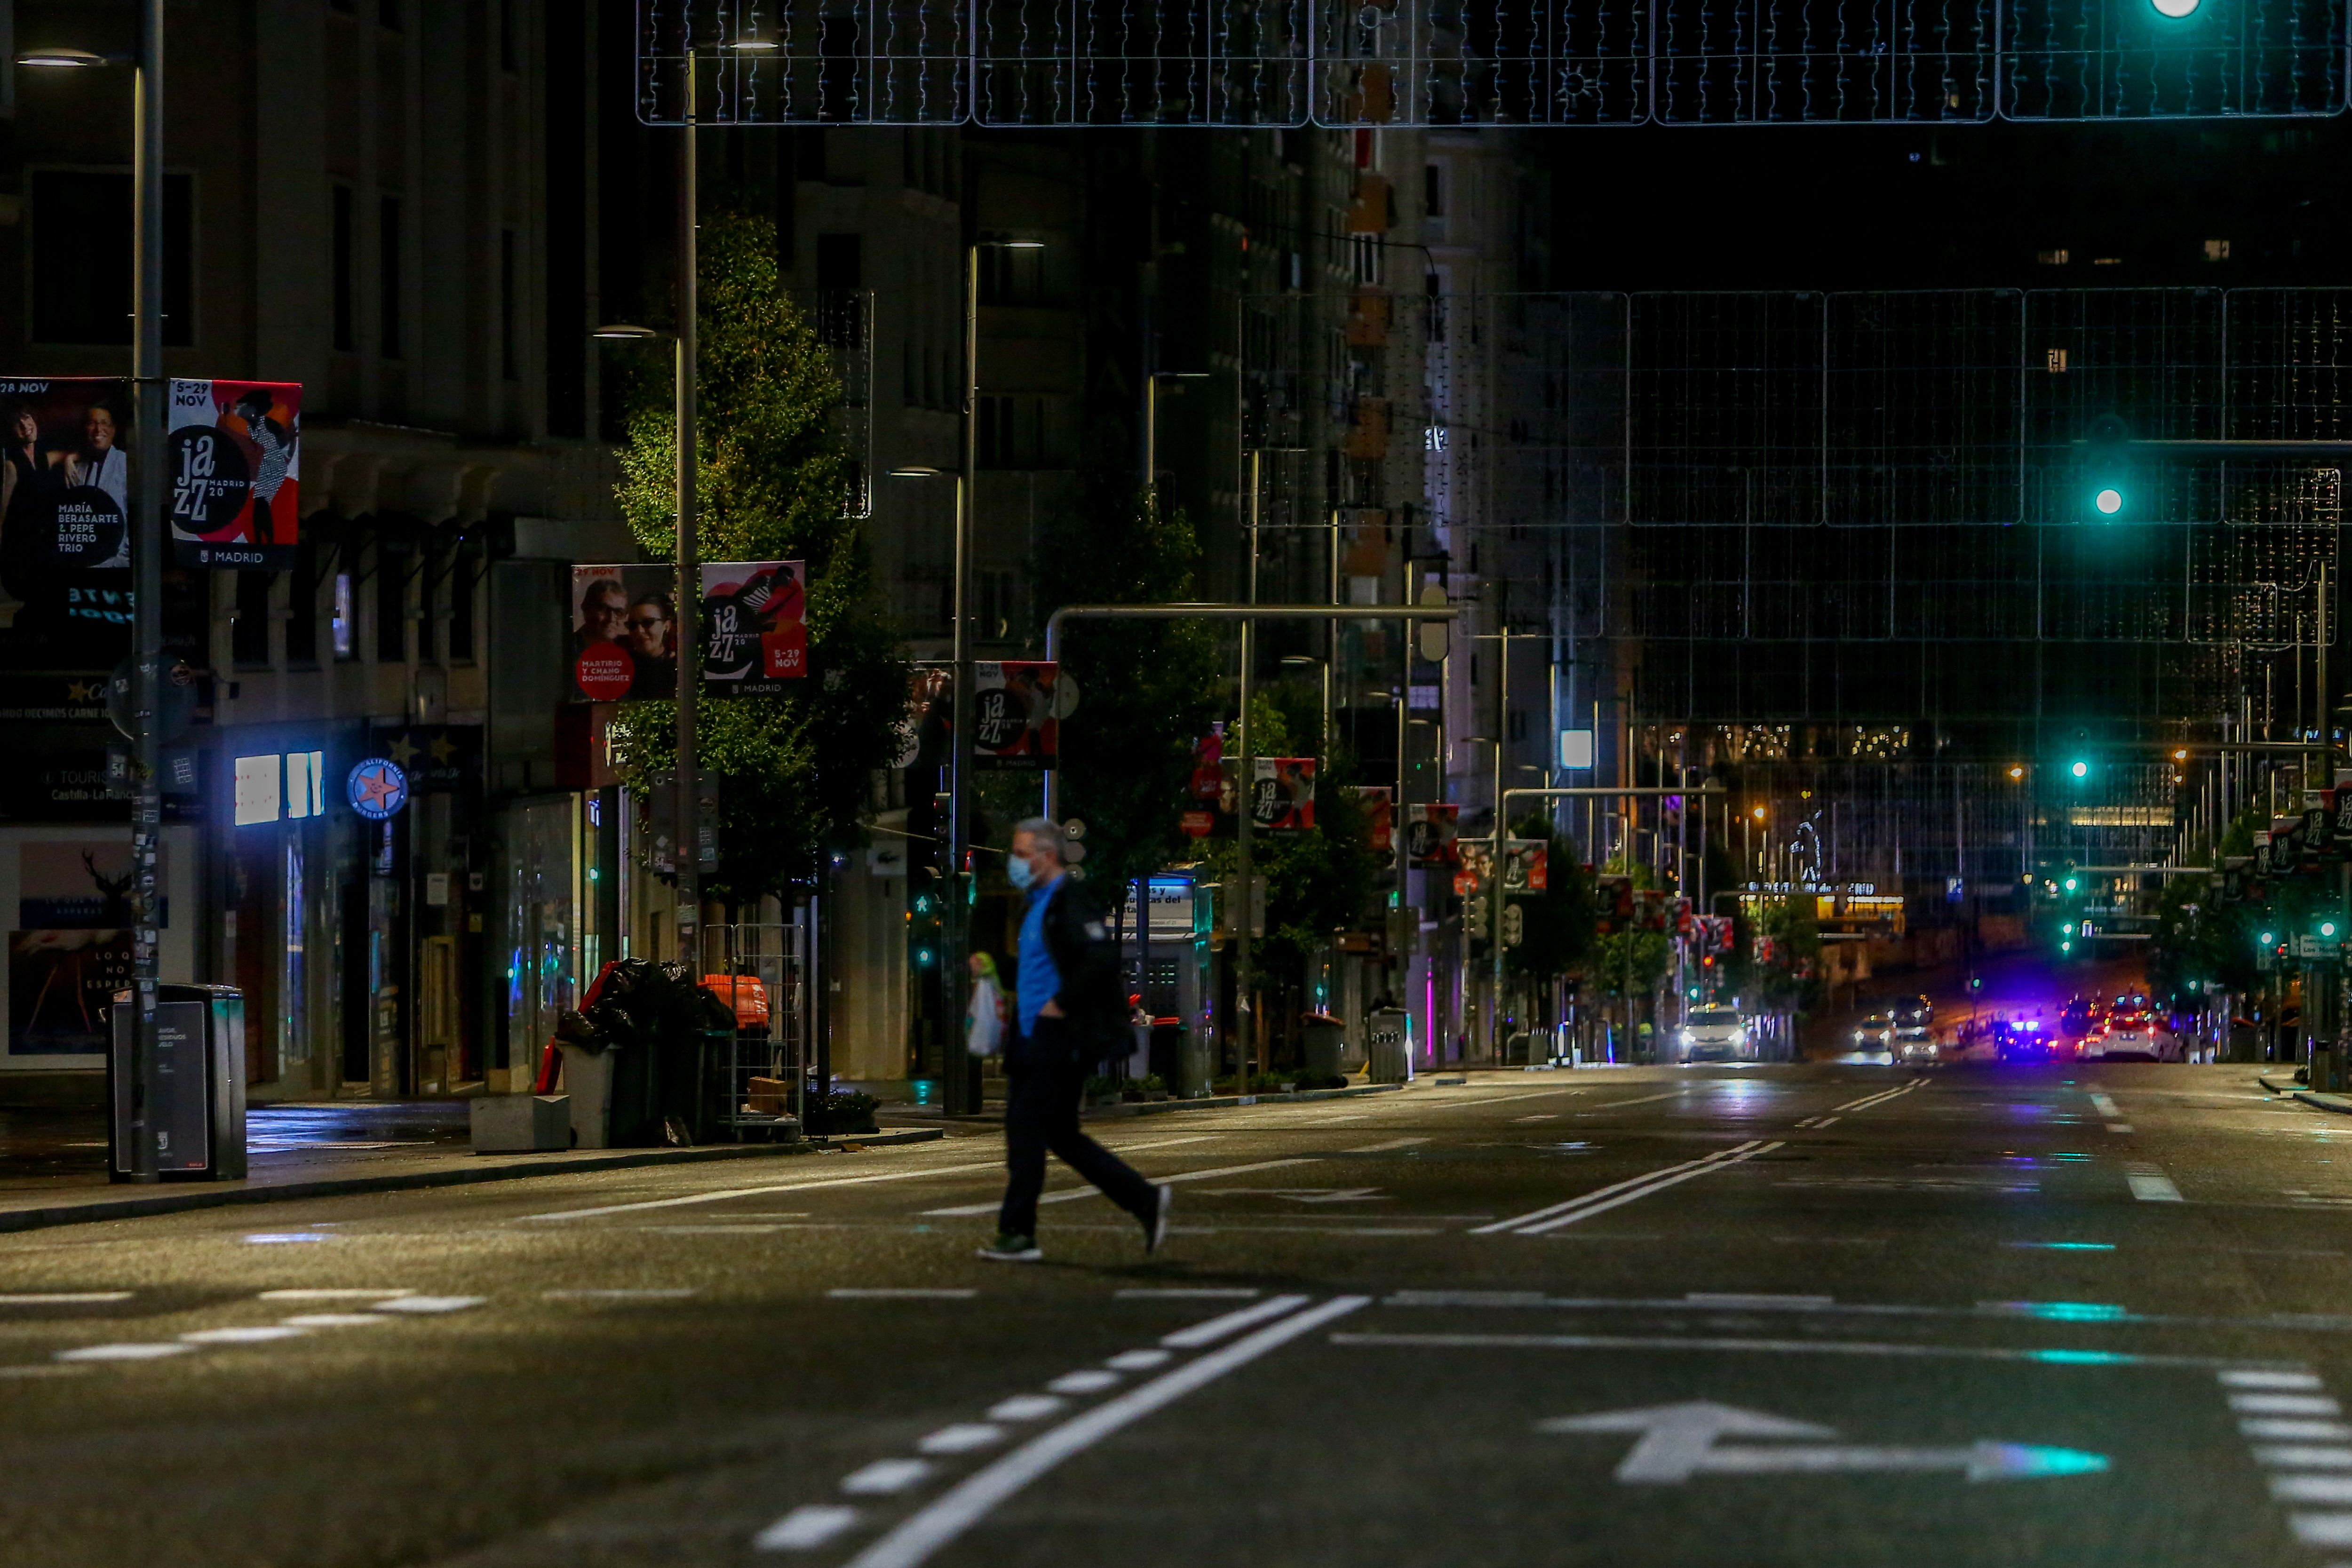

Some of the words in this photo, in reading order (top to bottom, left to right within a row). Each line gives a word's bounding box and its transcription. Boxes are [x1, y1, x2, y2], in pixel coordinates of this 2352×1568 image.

[0, 382, 15, 393] 28
[19, 382, 48, 393] NOV
[176, 382, 208, 394] 5-29
[176, 395, 206, 406] NOV
[209, 479, 245, 487] MADRID
[209, 487, 224, 497] 20
[58, 501, 93, 513] MARÍA
[58, 514, 118, 524] BERASARTE
[70, 524, 94, 533] PEPE
[58, 533, 96, 543] RIVERO
[58, 543, 83, 552] TRIO
[215, 552, 263, 563] MADRID
[774, 649, 800, 658] 5-29
[775, 659, 799, 668] NOV
[68, 708, 98, 719] CARNE
[360, 759, 405, 781] CALIFORNIA
[351, 801, 389, 818] BURGERS
[95, 951, 112, 961] LO
[106, 965, 125, 974] NO
